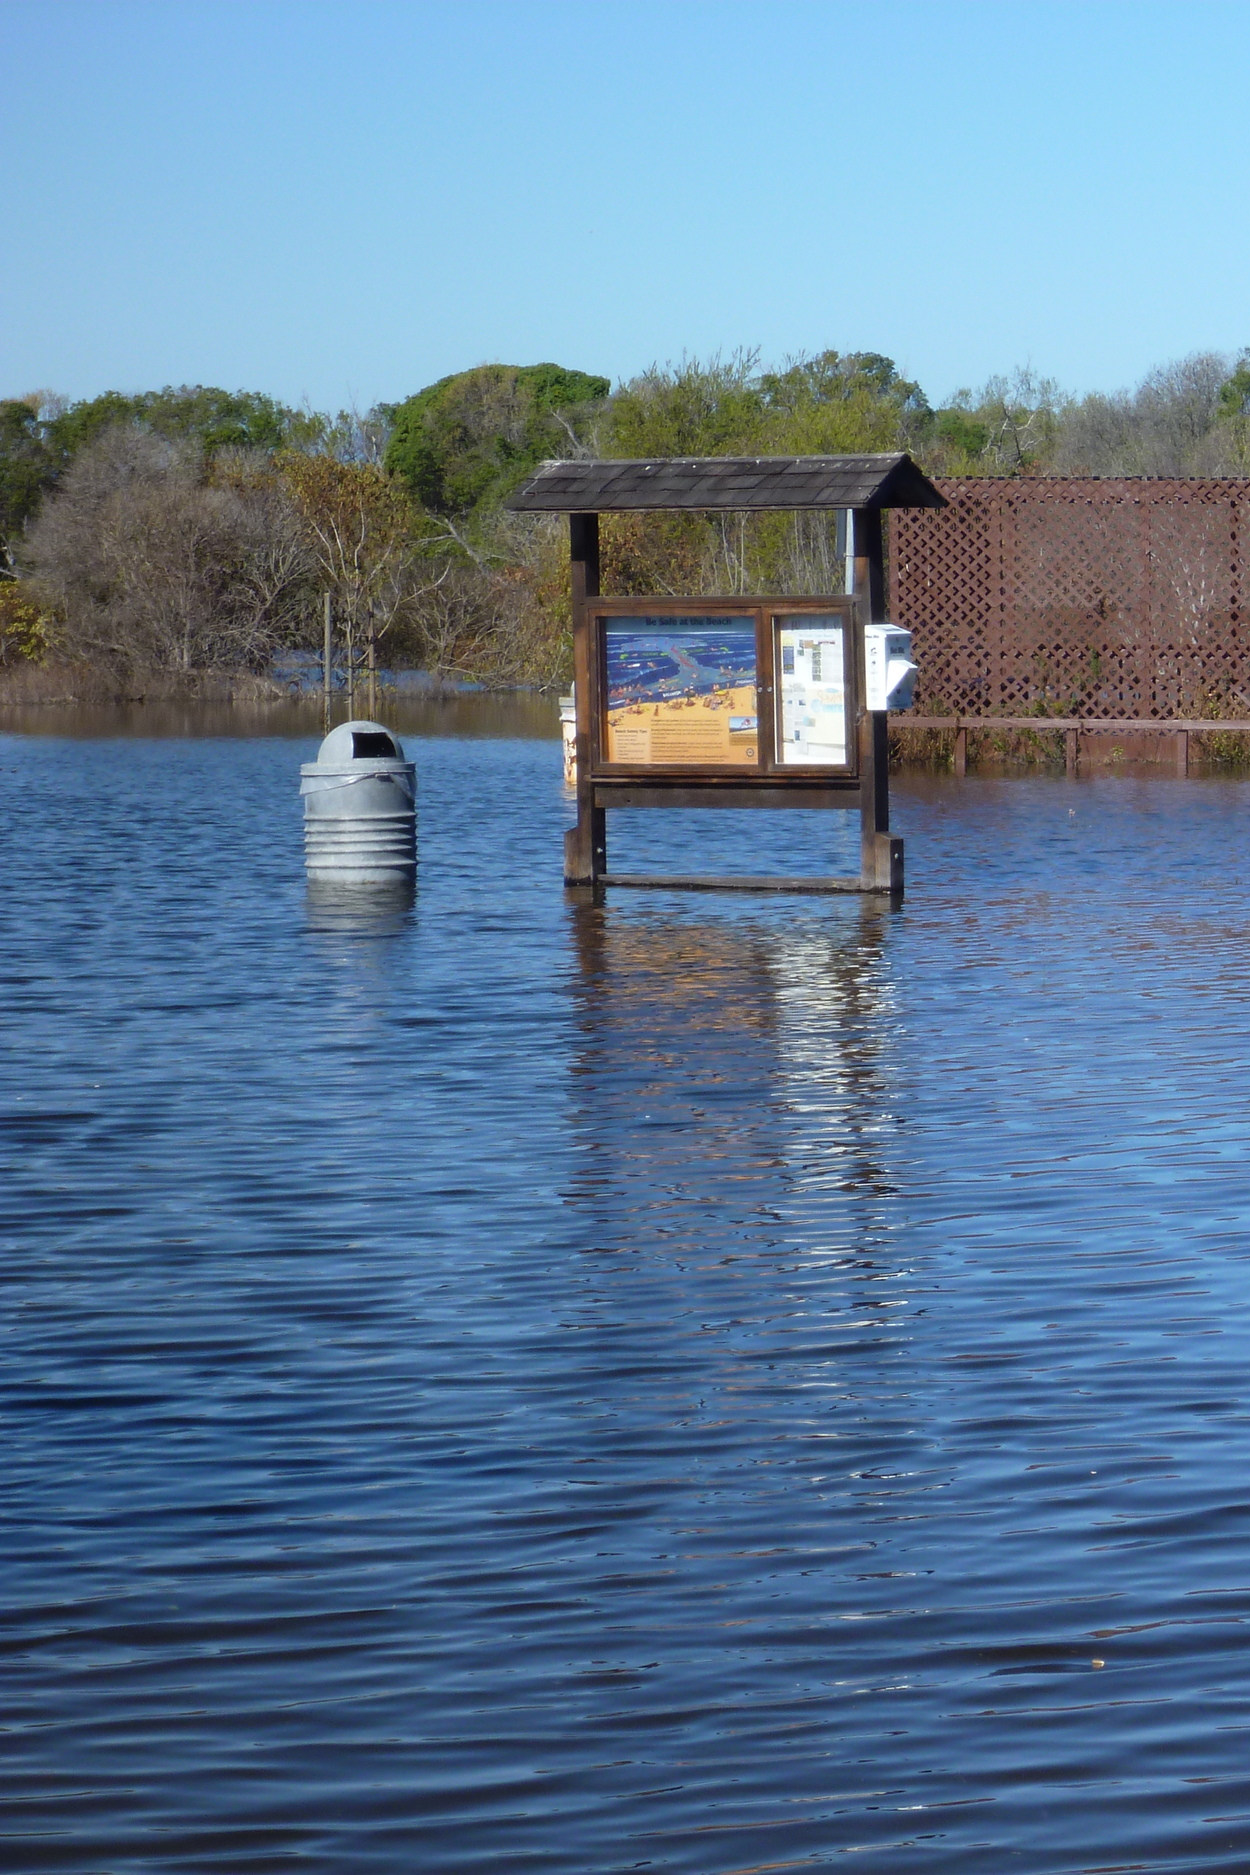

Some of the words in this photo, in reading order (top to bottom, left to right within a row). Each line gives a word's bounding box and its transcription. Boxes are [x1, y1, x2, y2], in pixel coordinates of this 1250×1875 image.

[645, 617, 657, 626] Be
[659, 617, 677, 626] Safe
[679, 617, 688, 626] at
[690, 617, 704, 626] the
[706, 617, 732, 626] Beach
